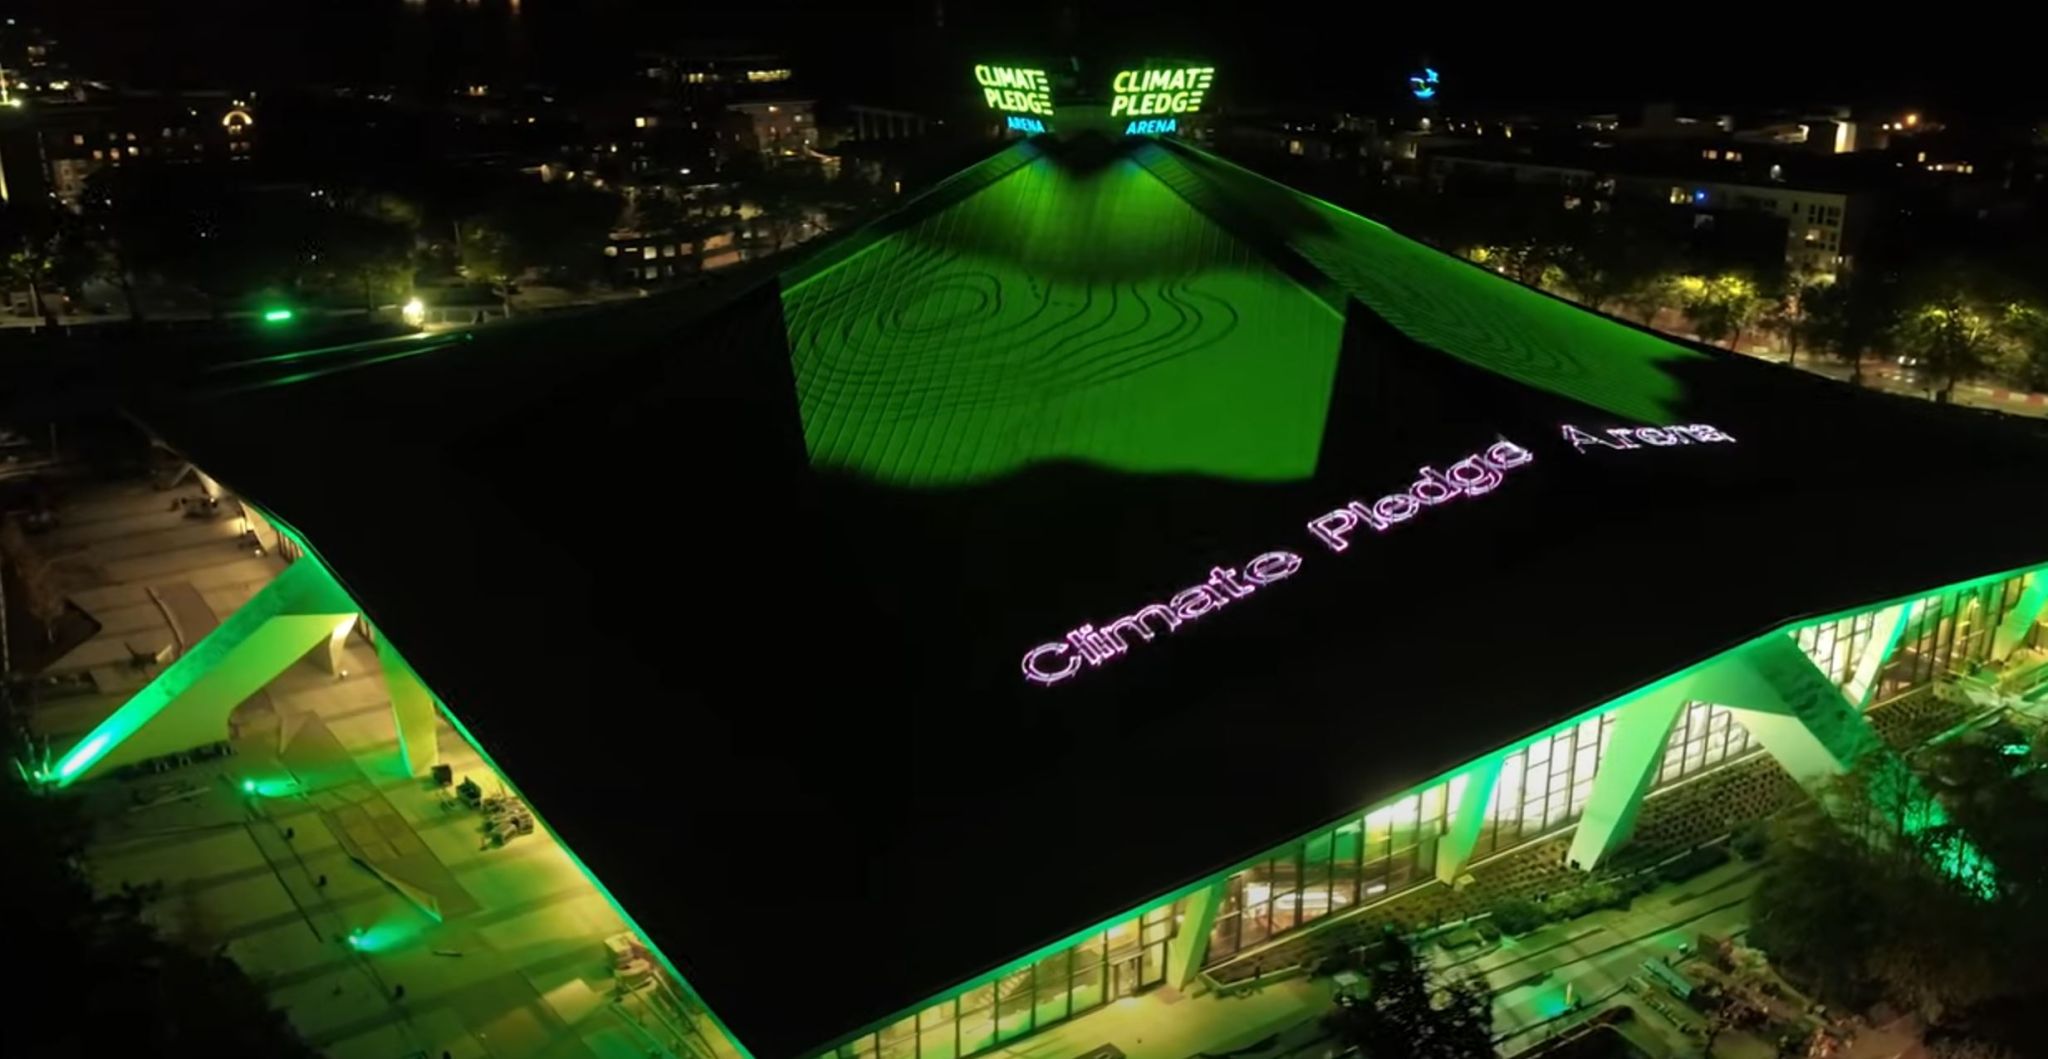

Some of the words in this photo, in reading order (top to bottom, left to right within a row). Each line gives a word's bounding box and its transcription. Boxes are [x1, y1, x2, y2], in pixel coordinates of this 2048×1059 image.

[975, 64, 1050, 92] CLIMATE
[1113, 68, 1215, 92] CLIMATE
[985, 88, 1054, 115] PLEDGE
[1111, 91, 1204, 117] PLEDGE
[1007, 116, 1045, 133] ARENA
[1126, 118, 1177, 135] ARENA
[1021, 550, 1303, 686] Climate
[1308, 438, 1534, 551] Pledge
[1561, 423, 1736, 453] Arena
